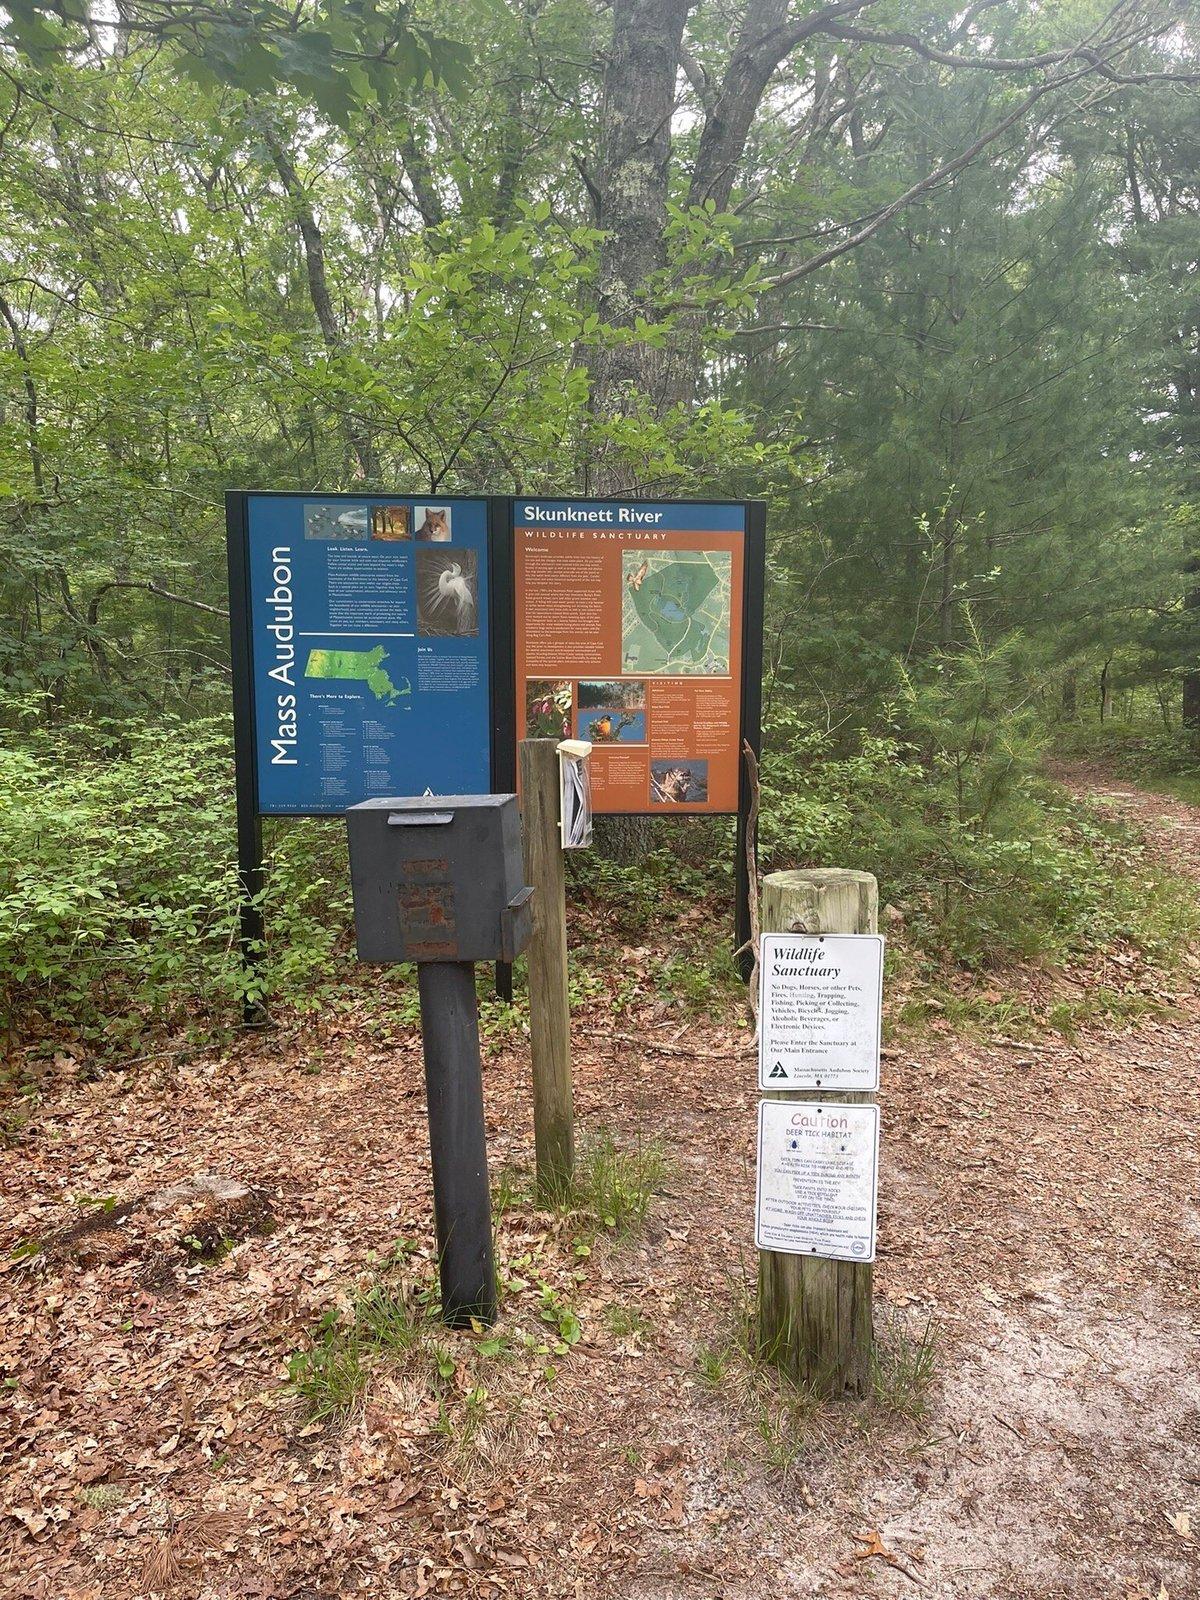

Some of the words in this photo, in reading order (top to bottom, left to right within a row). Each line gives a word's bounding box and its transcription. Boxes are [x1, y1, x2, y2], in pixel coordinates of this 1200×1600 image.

[524, 506, 613, 522] Skunknett
[618, 508, 663, 523] River
[524, 531, 585, 539] WILDLIFE
[592, 532, 667, 540] SANCTUARY
[266, 546, 296, 687] Audubon
[270, 694, 298, 765] Mass
[774, 948, 826, 964] Wildlife
[772, 964, 841, 980] Sanctuary
[791, 1113, 848, 1128] Caution
